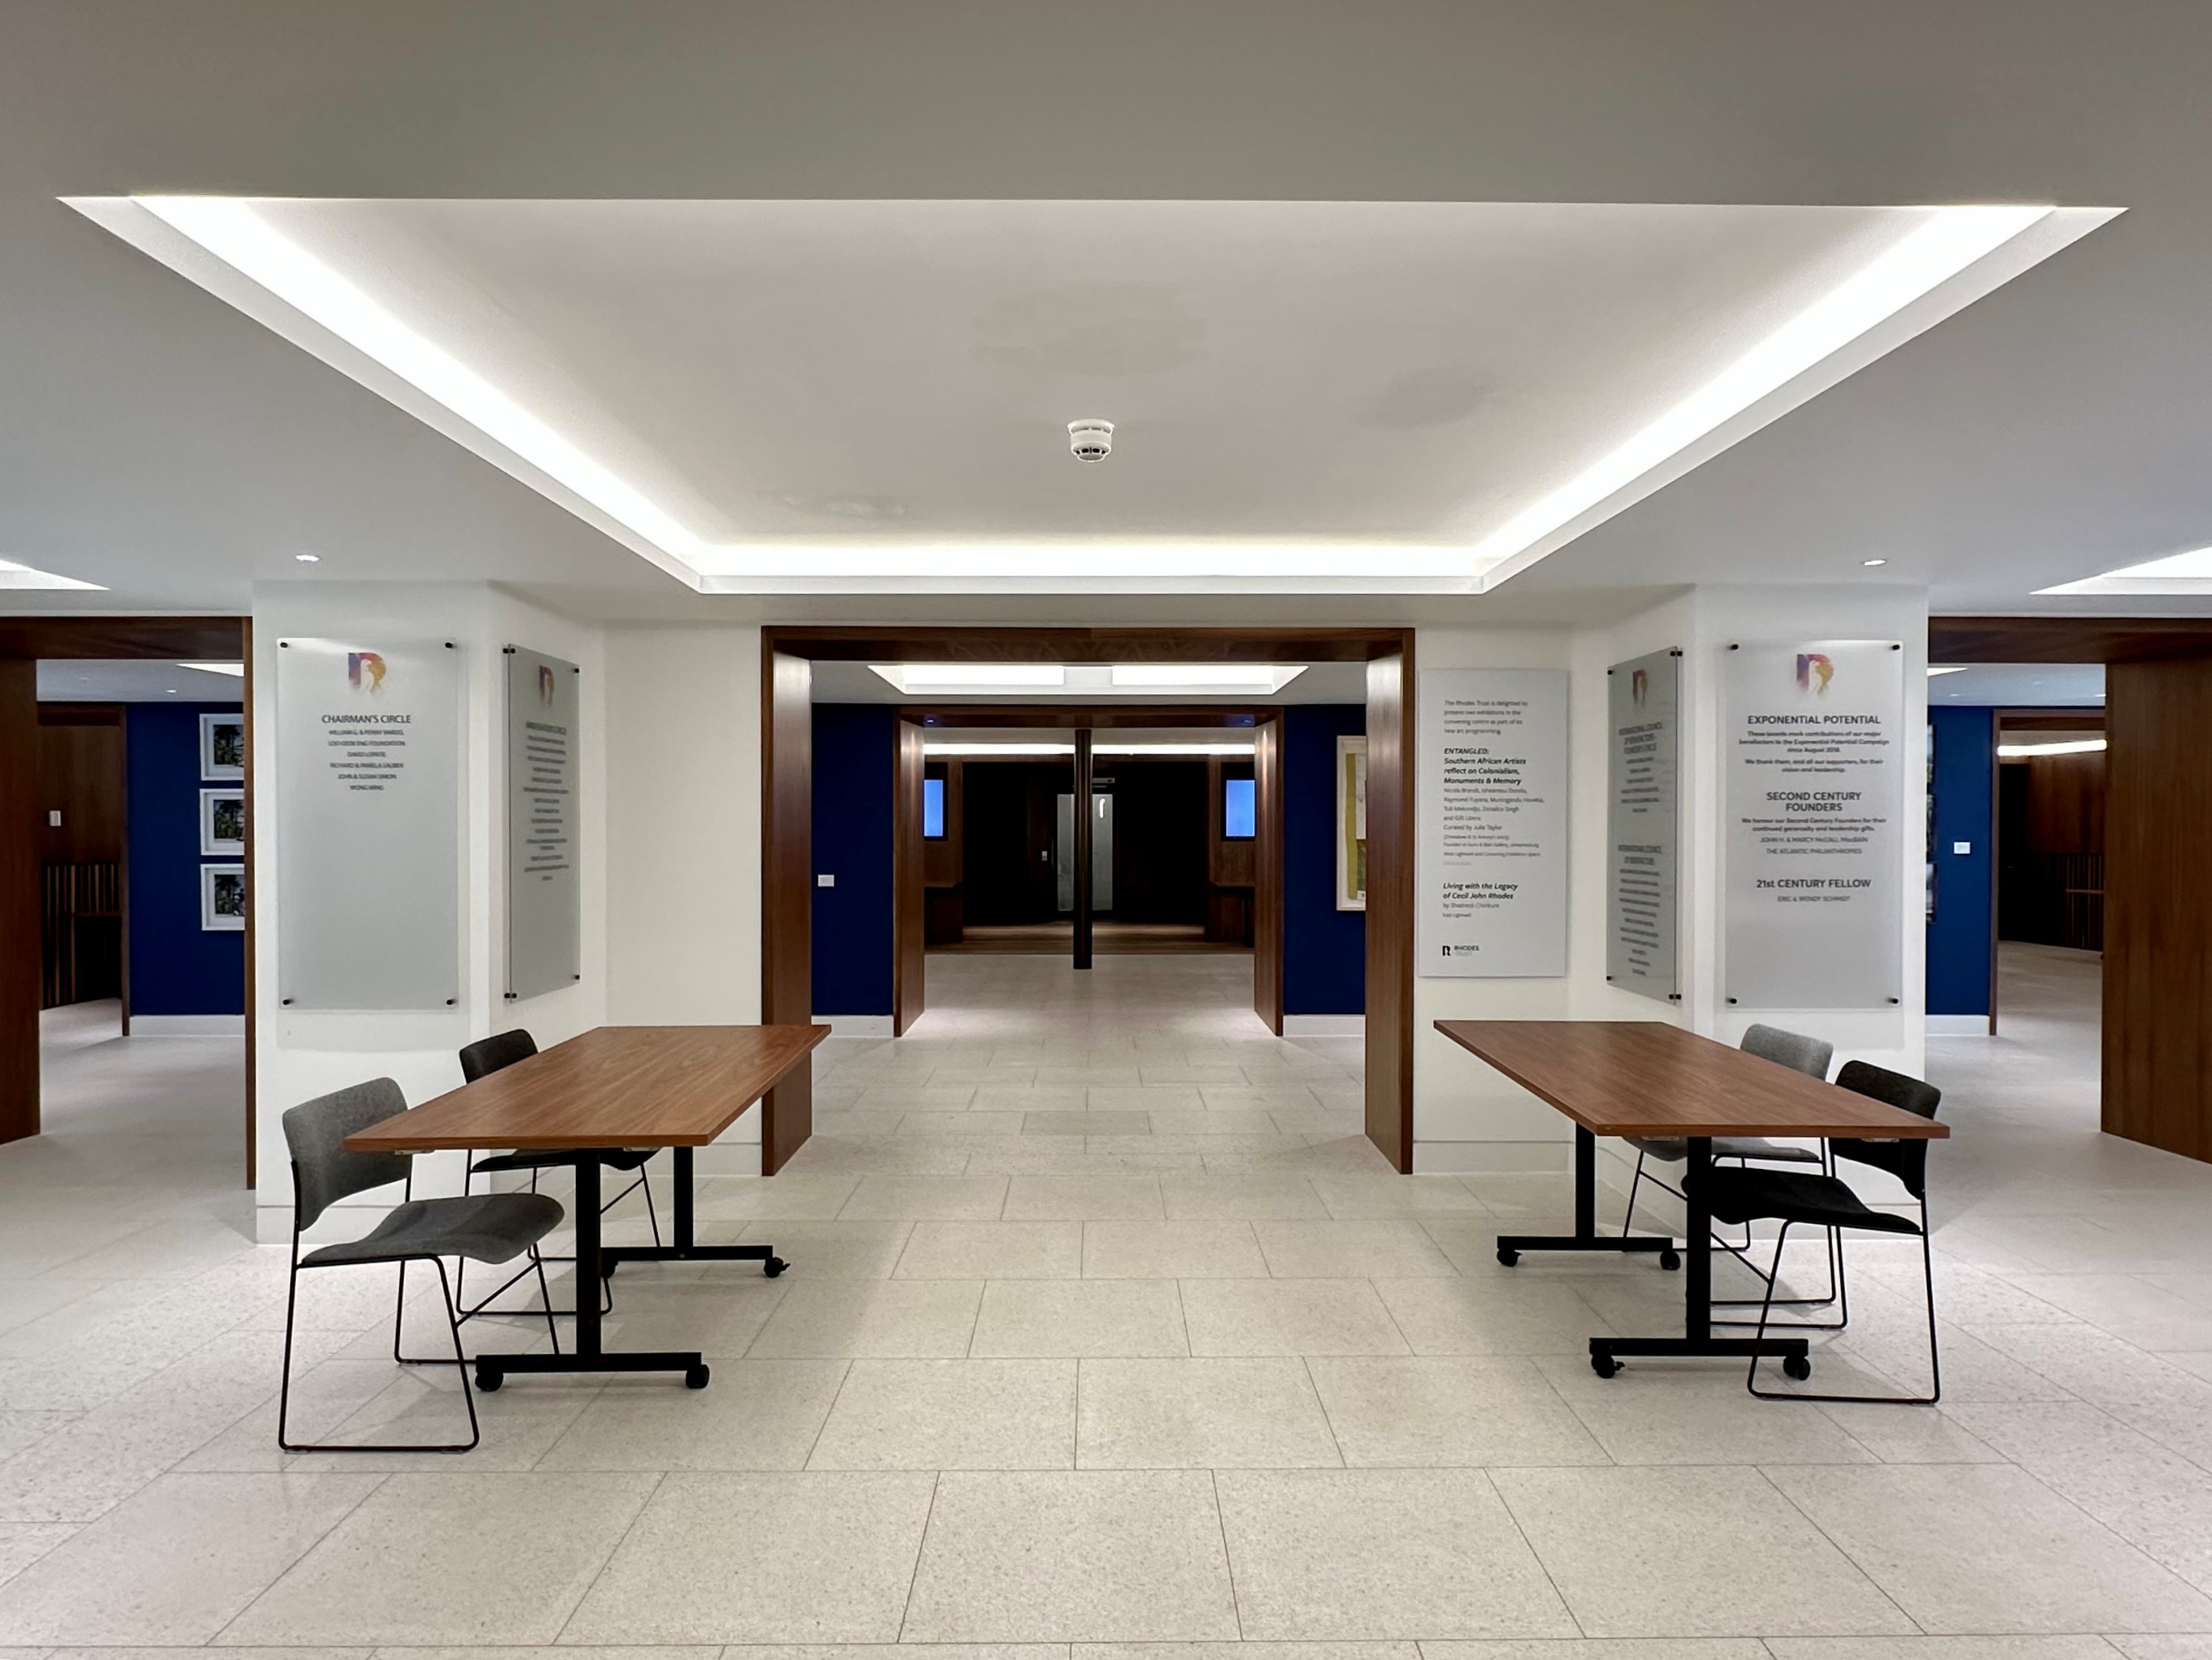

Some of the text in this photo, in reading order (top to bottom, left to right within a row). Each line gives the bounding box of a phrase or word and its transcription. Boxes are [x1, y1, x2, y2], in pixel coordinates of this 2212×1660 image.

[322, 715, 411, 724] CHAIRMAN'S CIRCLE
[1748, 715, 1880, 724] EXPONENTIAL POTENTIAL
[1767, 792, 1861, 800] SECOND CENTURY
[1786, 803, 1842, 811] FOUNDERS
[1756, 880, 1872, 888] 21st CENTURY FELLOW
